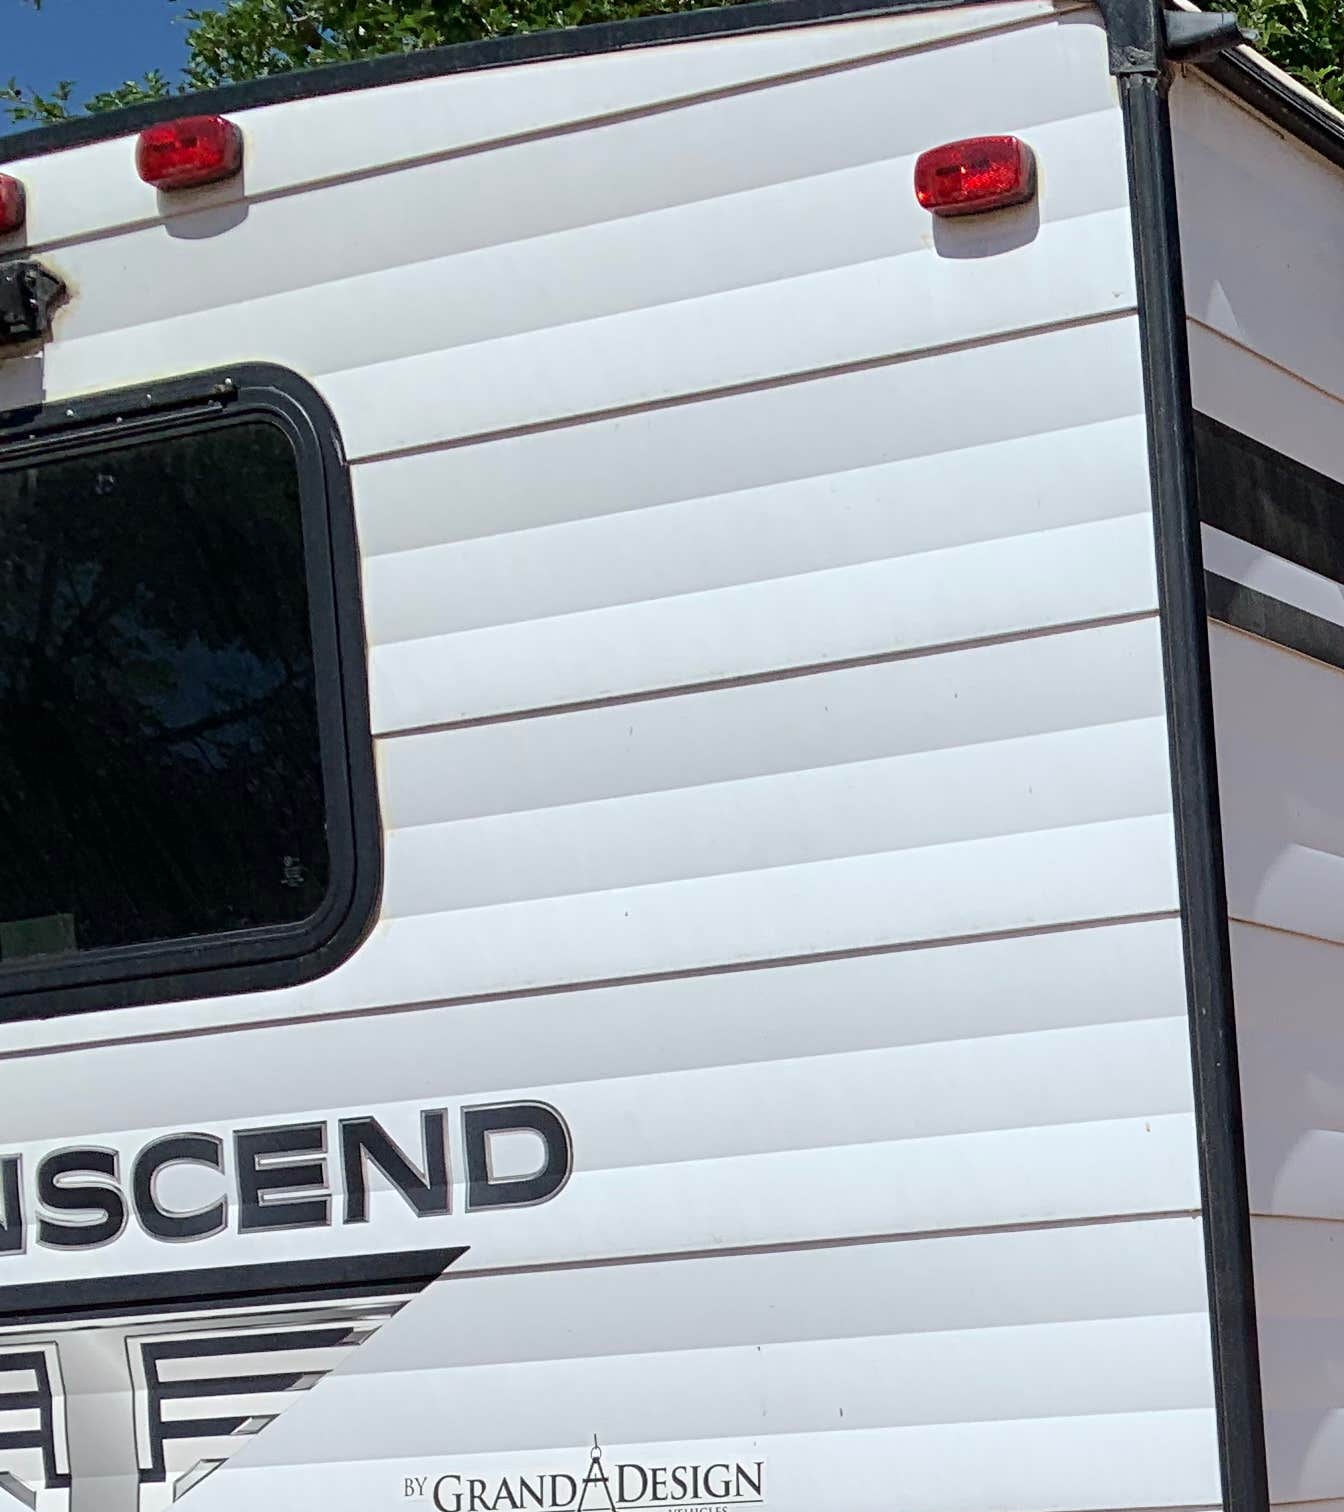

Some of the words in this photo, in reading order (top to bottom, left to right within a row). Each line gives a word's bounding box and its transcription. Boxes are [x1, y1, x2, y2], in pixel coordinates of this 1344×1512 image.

[0, 1098, 573, 1256] SCEND
[404, 1476, 428, 1497] BY
[615, 1461, 765, 1503] DESIGN
